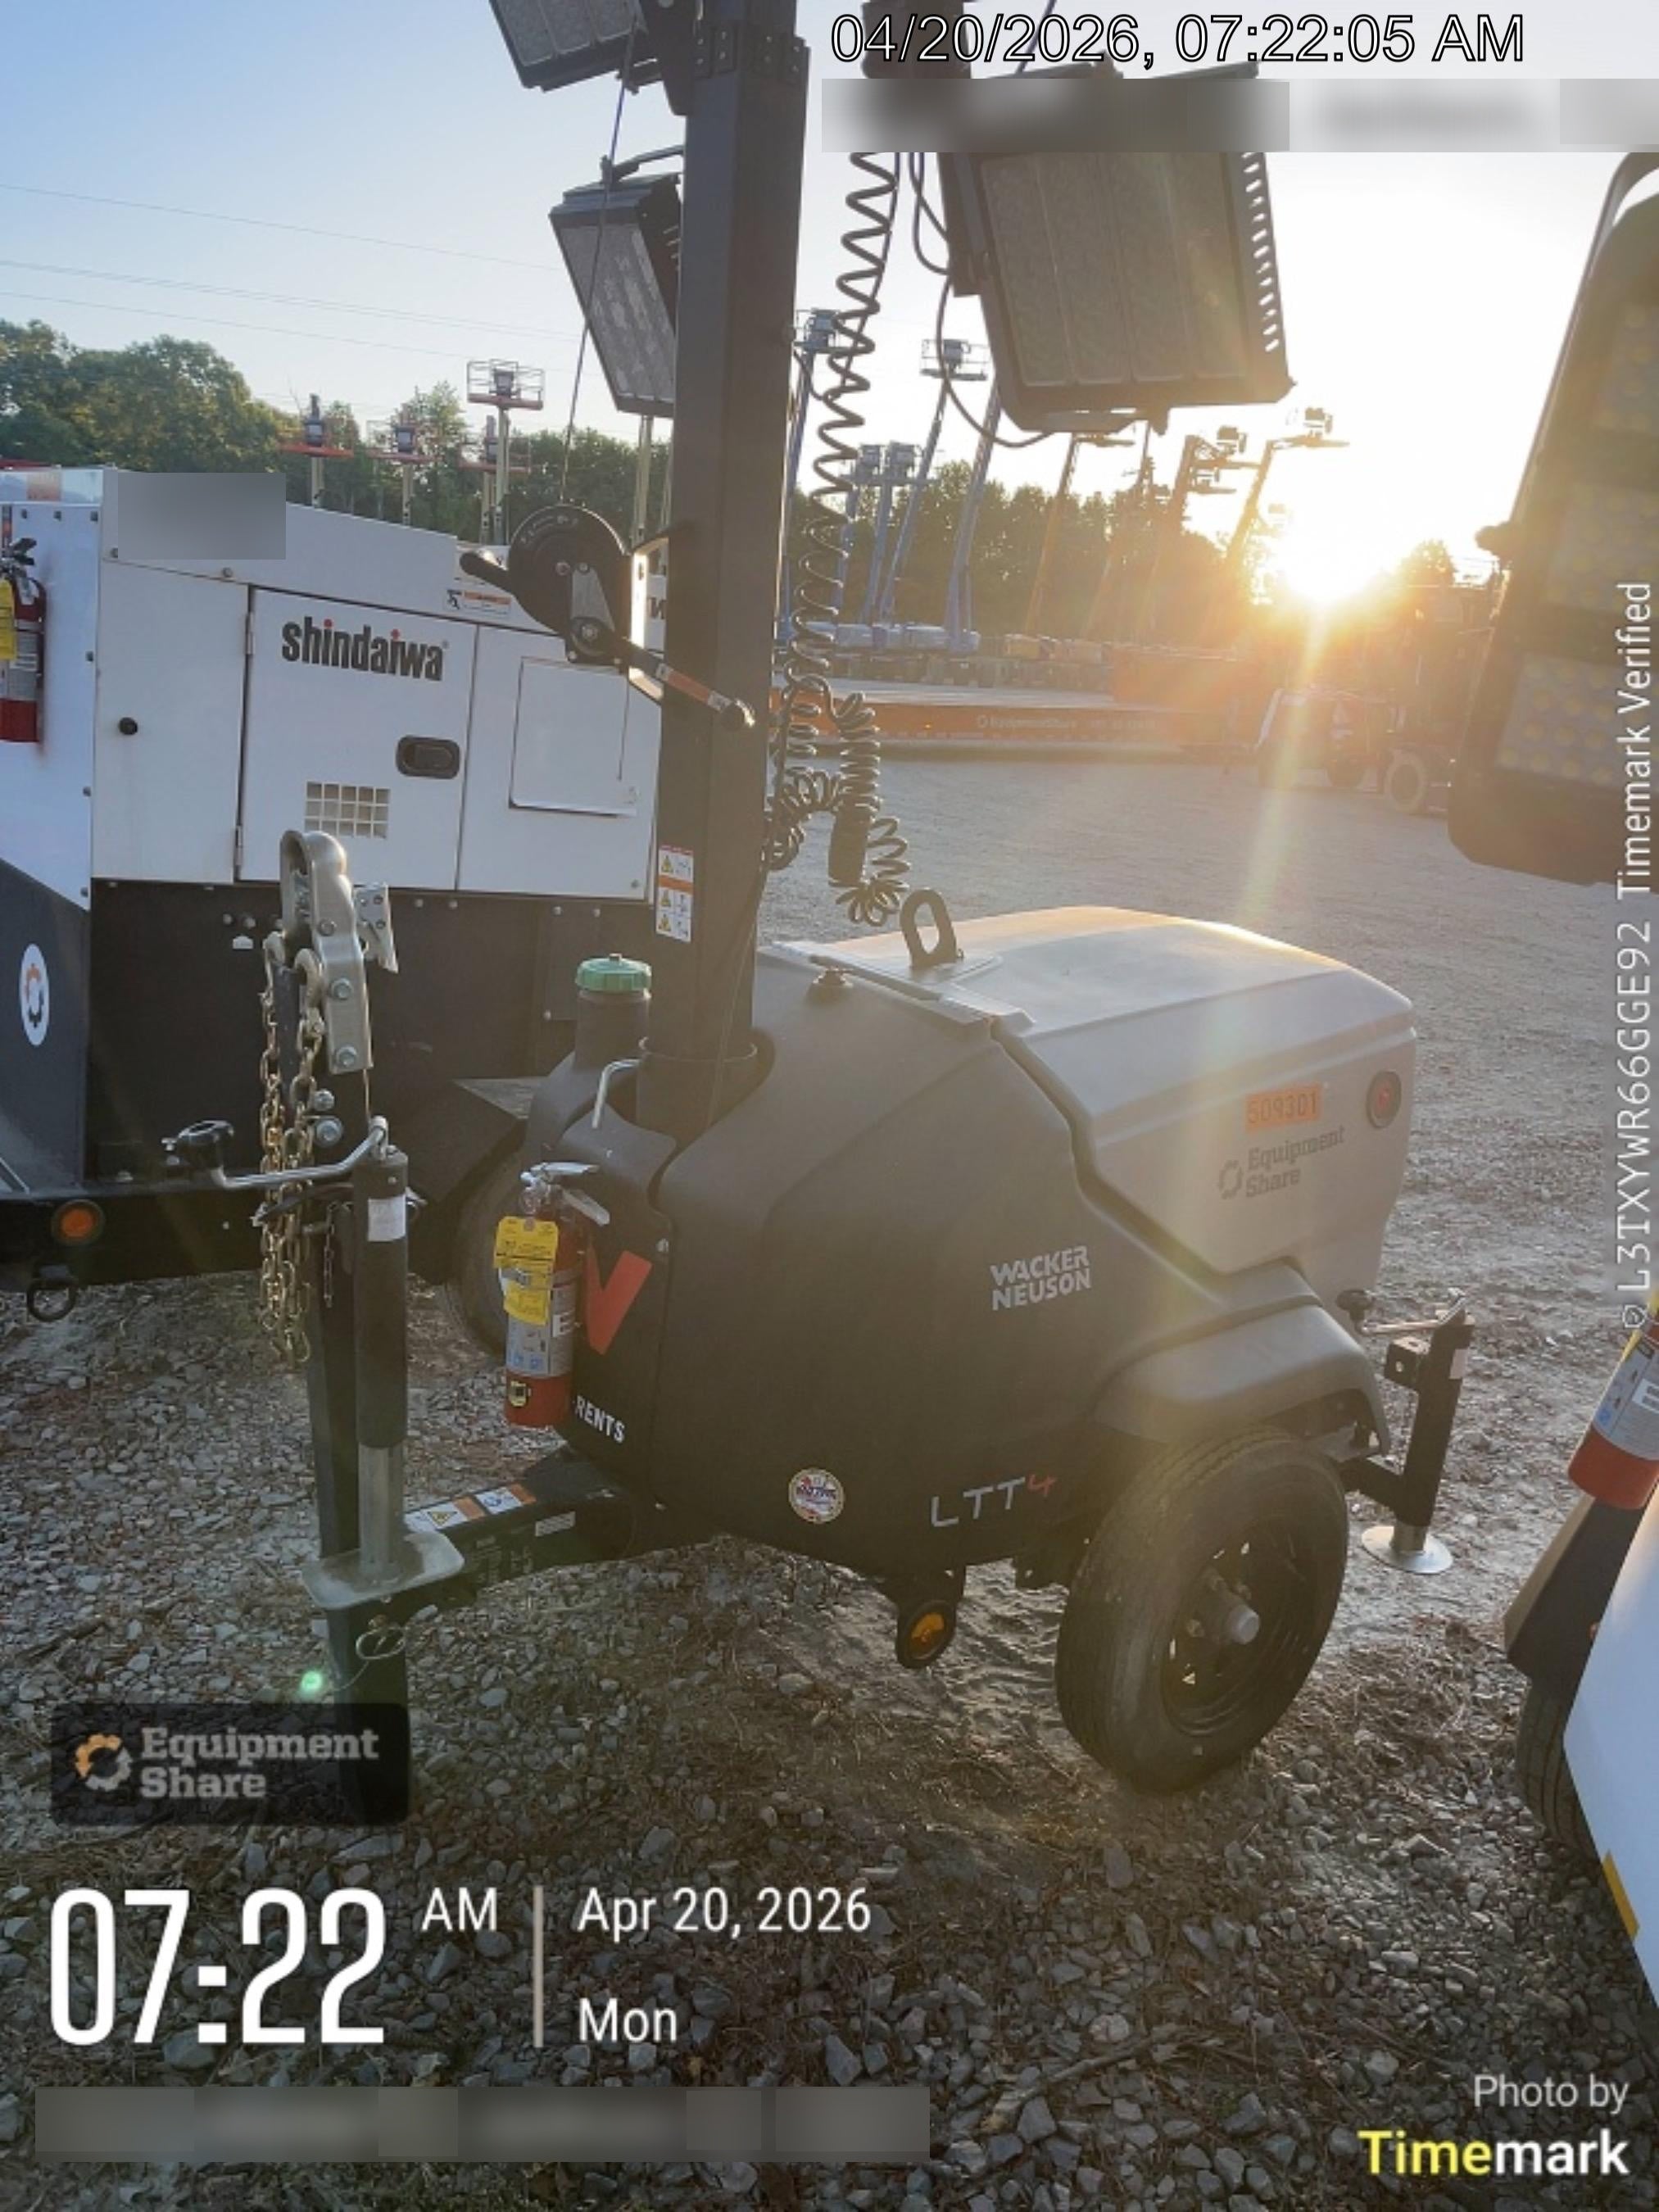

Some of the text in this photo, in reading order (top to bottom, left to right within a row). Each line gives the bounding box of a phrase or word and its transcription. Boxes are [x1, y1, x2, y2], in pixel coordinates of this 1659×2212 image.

[282, 616, 444, 681] shindaiwa
[1247, 1124, 1345, 1172] Equipment
[1246, 1168, 1301, 1197] Share
[990, 1245, 1090, 1286] WACKER
[992, 1268, 1091, 1311] NEUSON
[576, 1394, 625, 1444] RENTS
